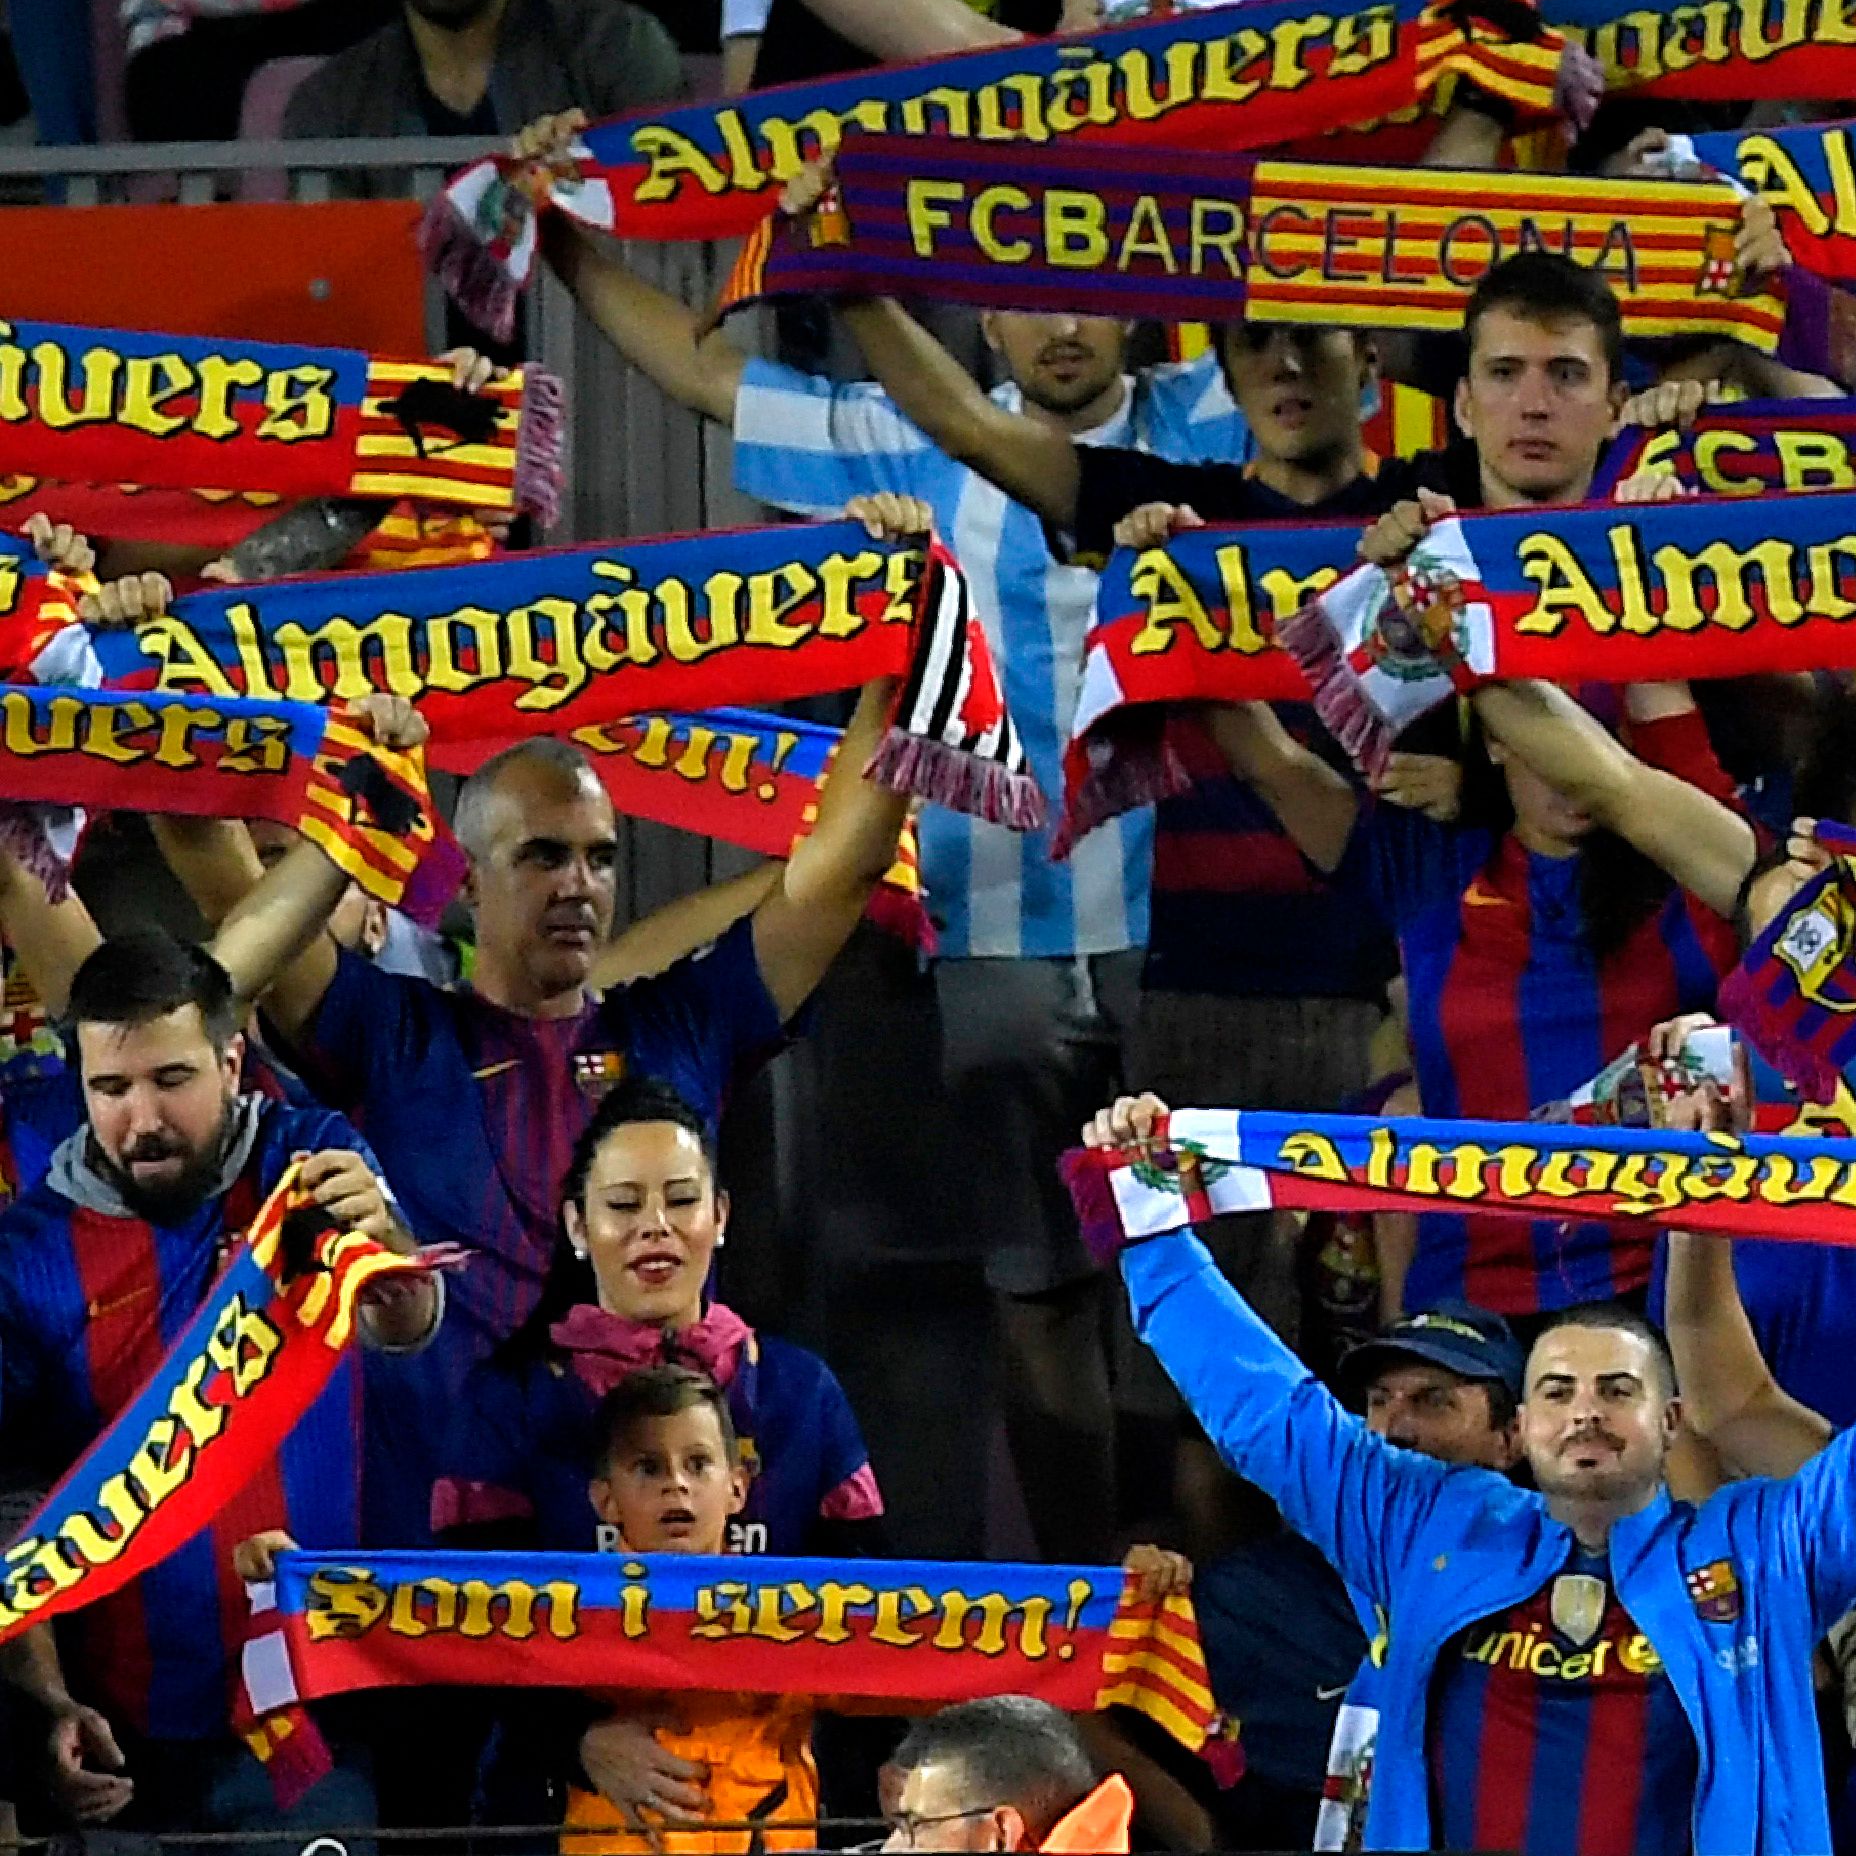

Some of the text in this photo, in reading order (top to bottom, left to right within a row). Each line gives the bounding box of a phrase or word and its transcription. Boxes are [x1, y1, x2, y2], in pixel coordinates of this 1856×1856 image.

[0, 1294, 283, 1634] àvers
[307, 1563, 1092, 1661] Som i serem!
